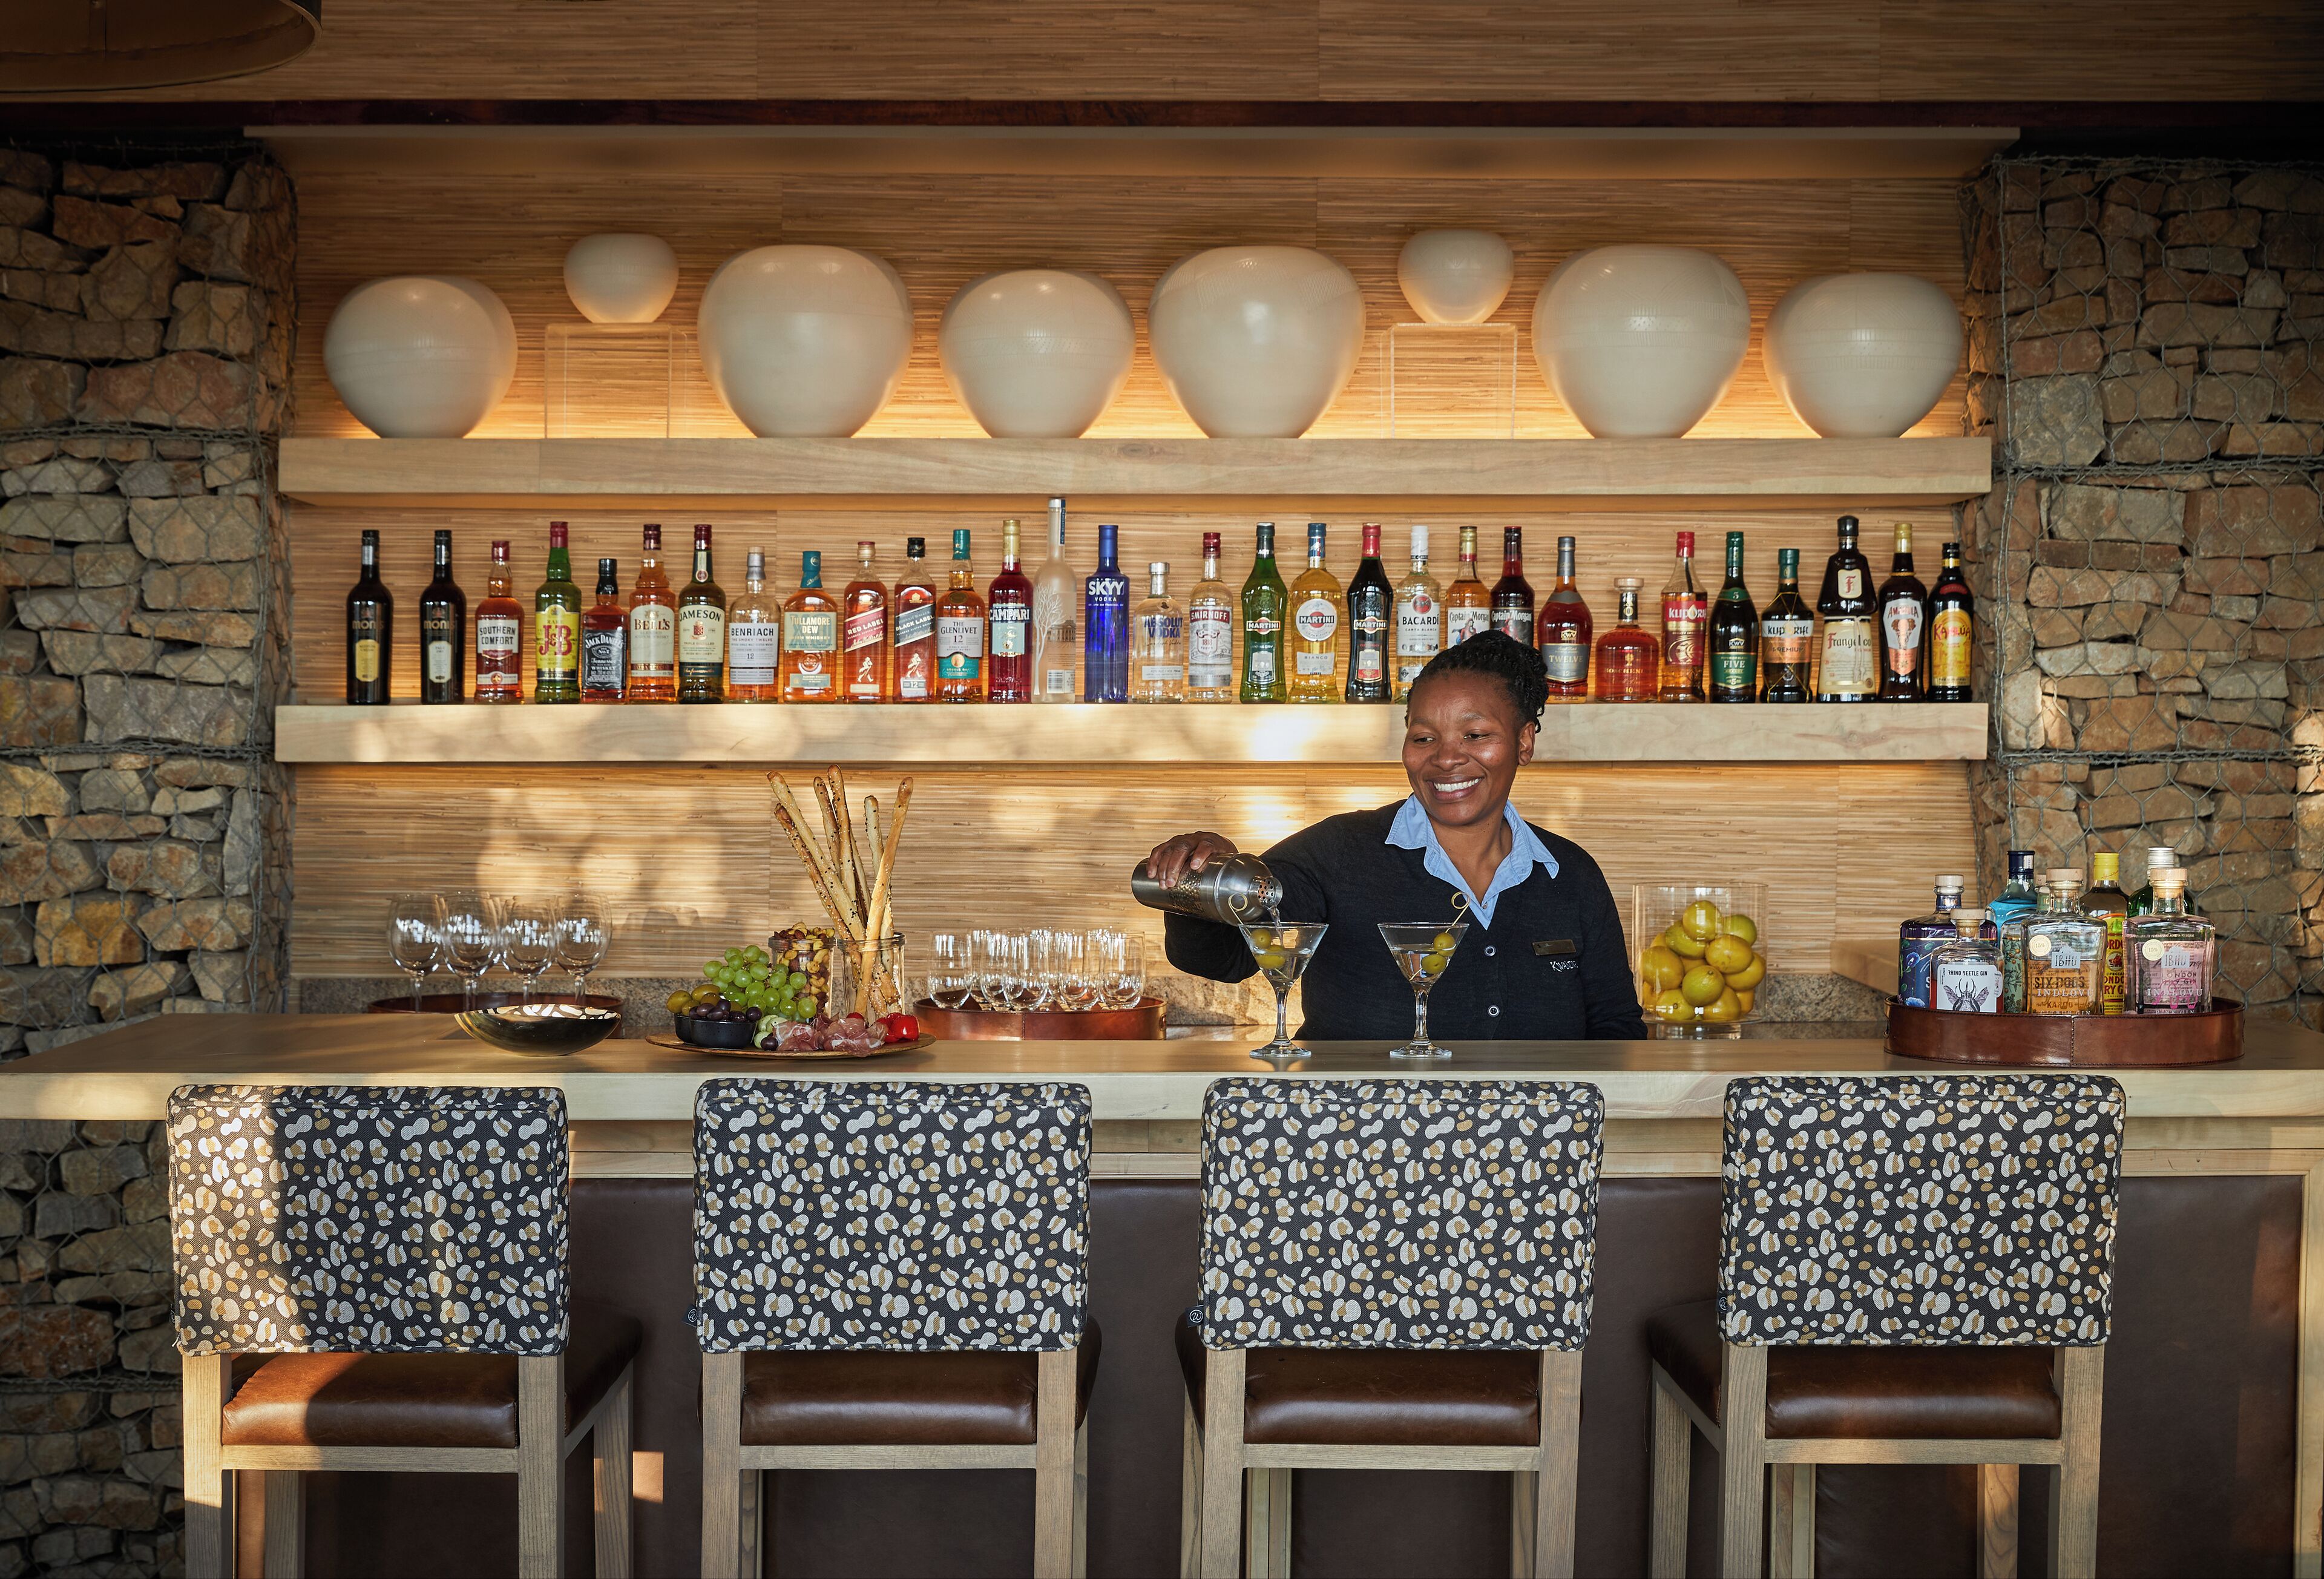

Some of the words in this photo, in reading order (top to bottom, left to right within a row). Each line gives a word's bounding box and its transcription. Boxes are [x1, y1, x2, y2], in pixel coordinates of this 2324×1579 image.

[1089, 581, 1124, 596] SKYY
[1845, 576, 1856, 594] F
[679, 609, 721, 622] JAMESON
[989, 608, 1029, 621] CAMPARI
[1402, 614, 1439, 625] BACARDÍ
[1491, 611, 1511, 622] Captain
[1511, 610, 1532, 622] Morgan
[634, 619, 670, 630] BELL'S
[790, 615, 830, 626] TULLAMORE
[1144, 617, 1183, 628] ABSOLUT
[479, 626, 516, 635] SOUTHERN
[802, 625, 818, 634] DEW
[847, 626, 862, 635] RED
[1148, 628, 1181, 638] VODKA
[481, 637, 514, 645] COMFORT
[585, 636, 601, 648] JACK
[1549, 654, 1583, 663] TWELVE
[2037, 988, 2093, 997] INDLOVU
